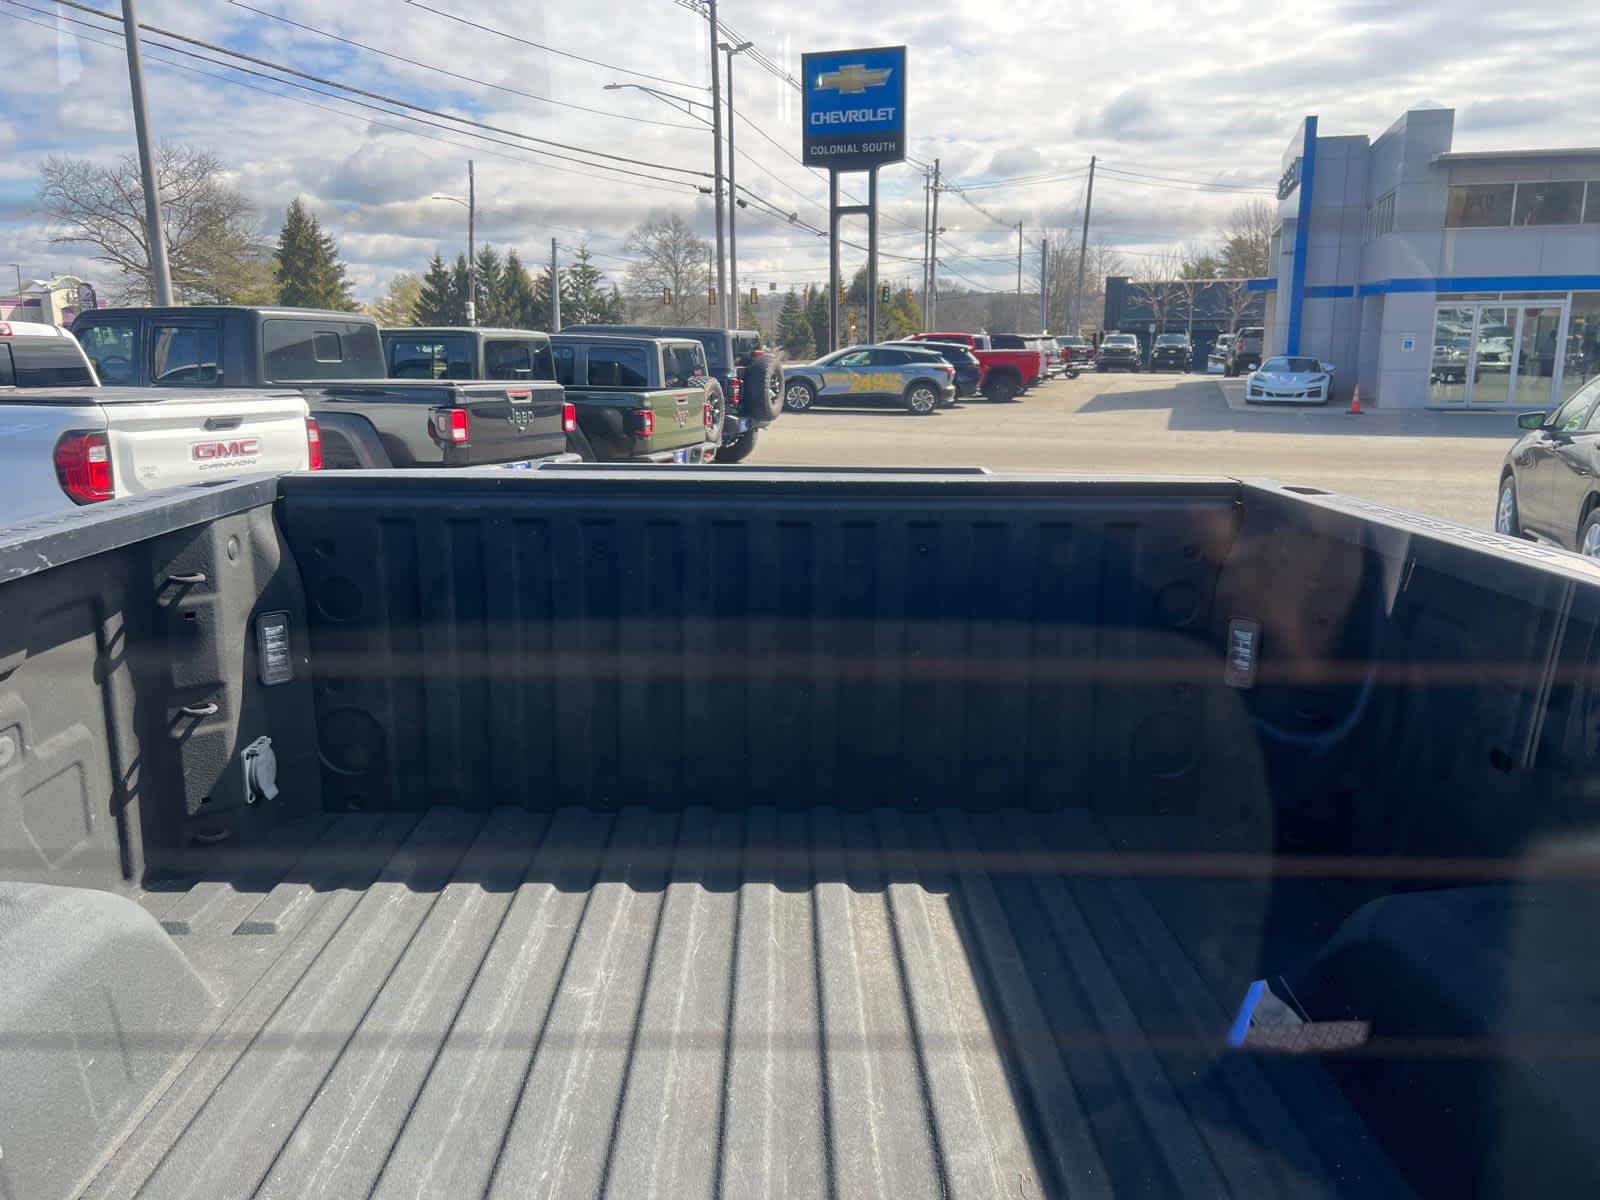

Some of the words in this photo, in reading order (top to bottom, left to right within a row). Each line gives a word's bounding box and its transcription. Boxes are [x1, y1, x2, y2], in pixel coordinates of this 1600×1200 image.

[811, 107, 896, 125] CHEVROLET
[811, 143, 859, 155] COLONIAL
[862, 141, 896, 153] SOUTH
[507, 407, 535, 424] Jeep
[193, 439, 258, 461] GMC
